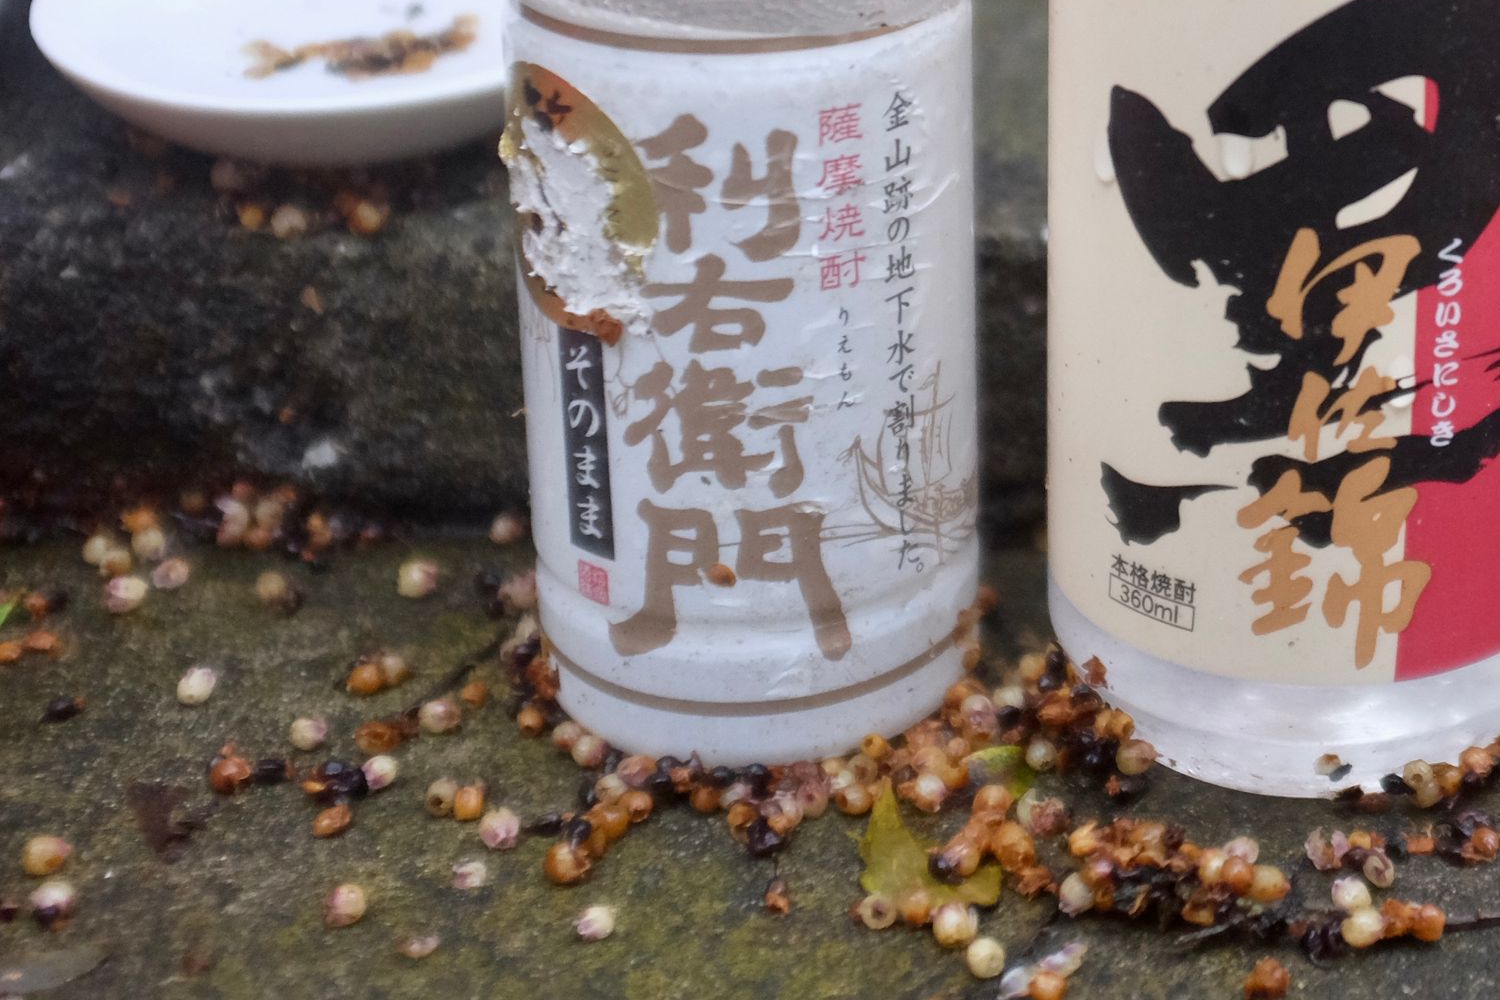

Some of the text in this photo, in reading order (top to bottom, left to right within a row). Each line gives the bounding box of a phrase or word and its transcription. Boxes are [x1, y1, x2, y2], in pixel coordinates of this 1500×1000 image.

[816, 103, 866, 291] 薩摩焼酎
[608, 113, 852, 661] 利右衛門
[837, 306, 856, 411] りえもん
[1430, 237, 1464, 448] くろいさにしき
[565, 345, 604, 540] そのまま
[1236, 227, 1432, 670] 伊佐錦
[1111, 553, 1196, 605] 本格焼酎
[1120, 584, 1179, 624] 360ml
